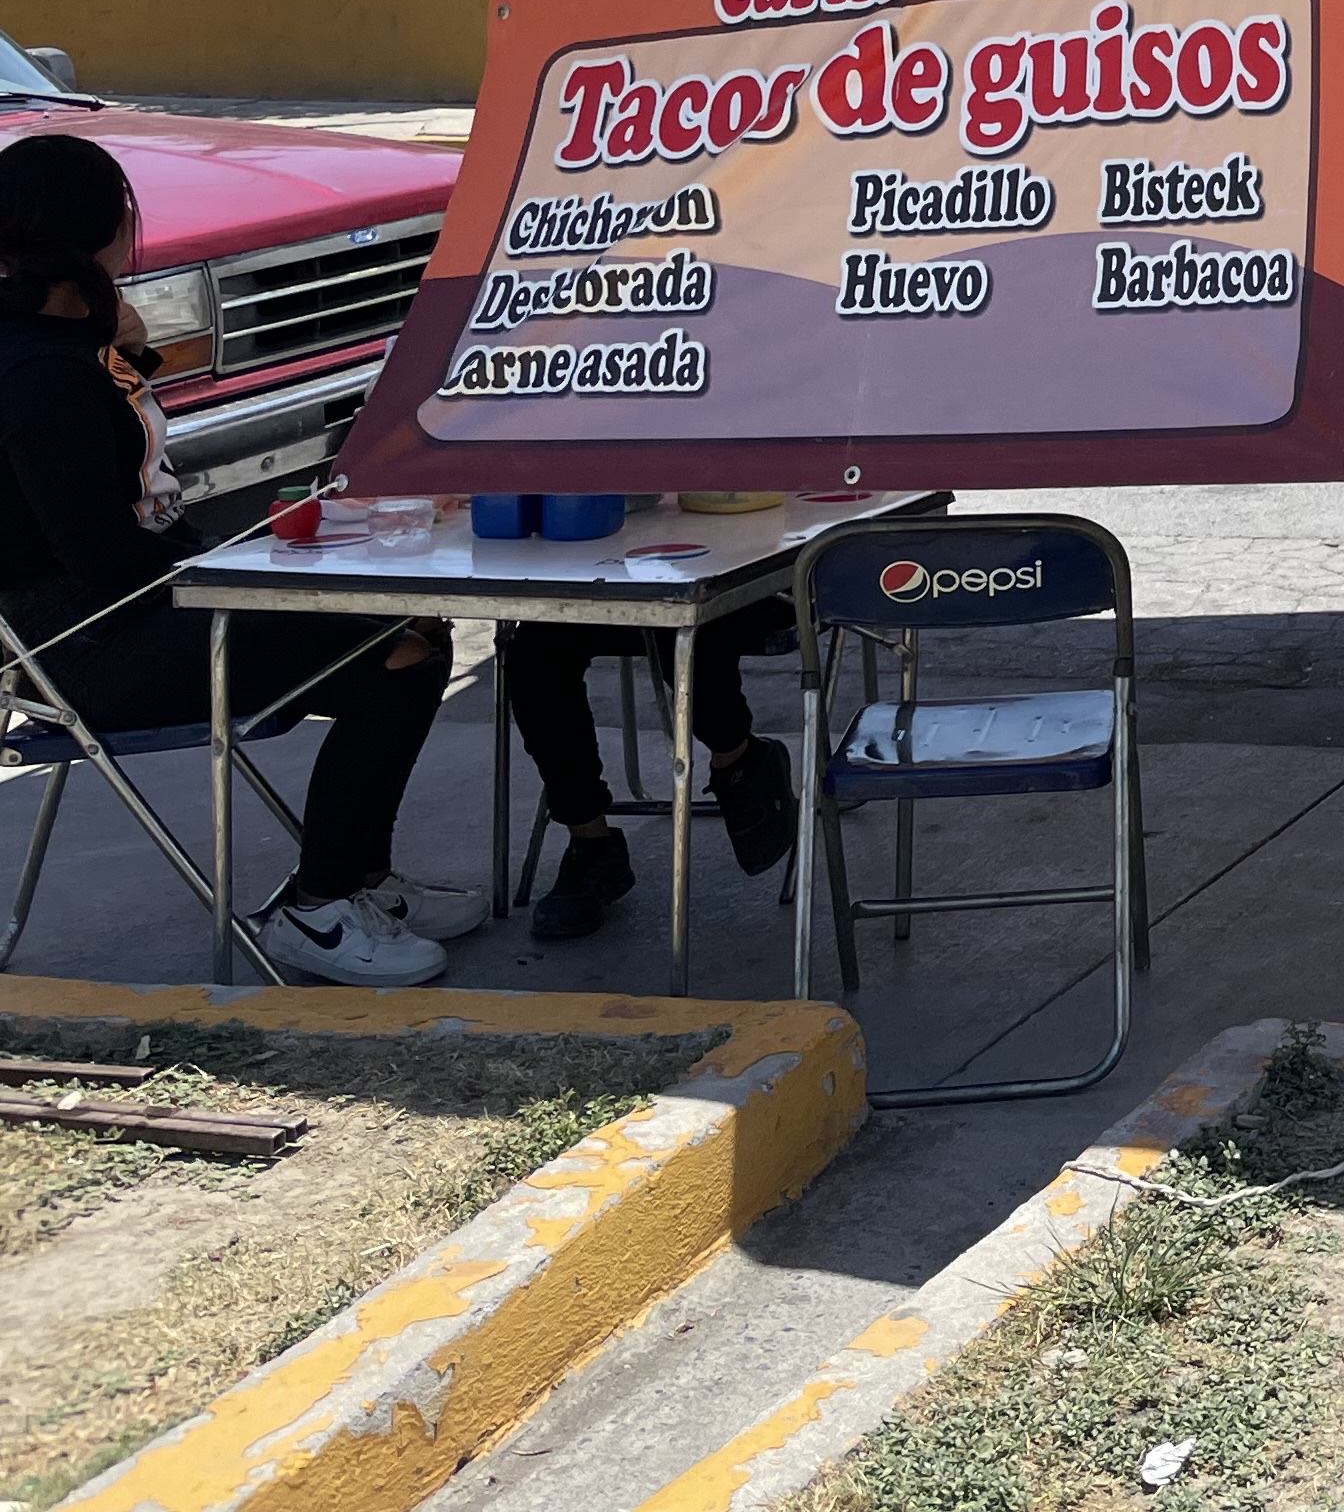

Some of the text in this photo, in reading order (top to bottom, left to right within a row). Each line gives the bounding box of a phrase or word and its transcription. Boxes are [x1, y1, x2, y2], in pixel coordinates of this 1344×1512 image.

[814, 23, 945, 130] de
[962, 2, 1284, 150] guisos
[849, 165, 1049, 230] Picadillo
[1100, 155, 1259, 219] Bisteck
[473, 250, 708, 325] Debrada
[837, 252, 984, 311] Huevo
[1093, 242, 1291, 305] Barbacoa
[575, 331, 702, 389] asada
[932, 558, 1043, 599] pepsi
